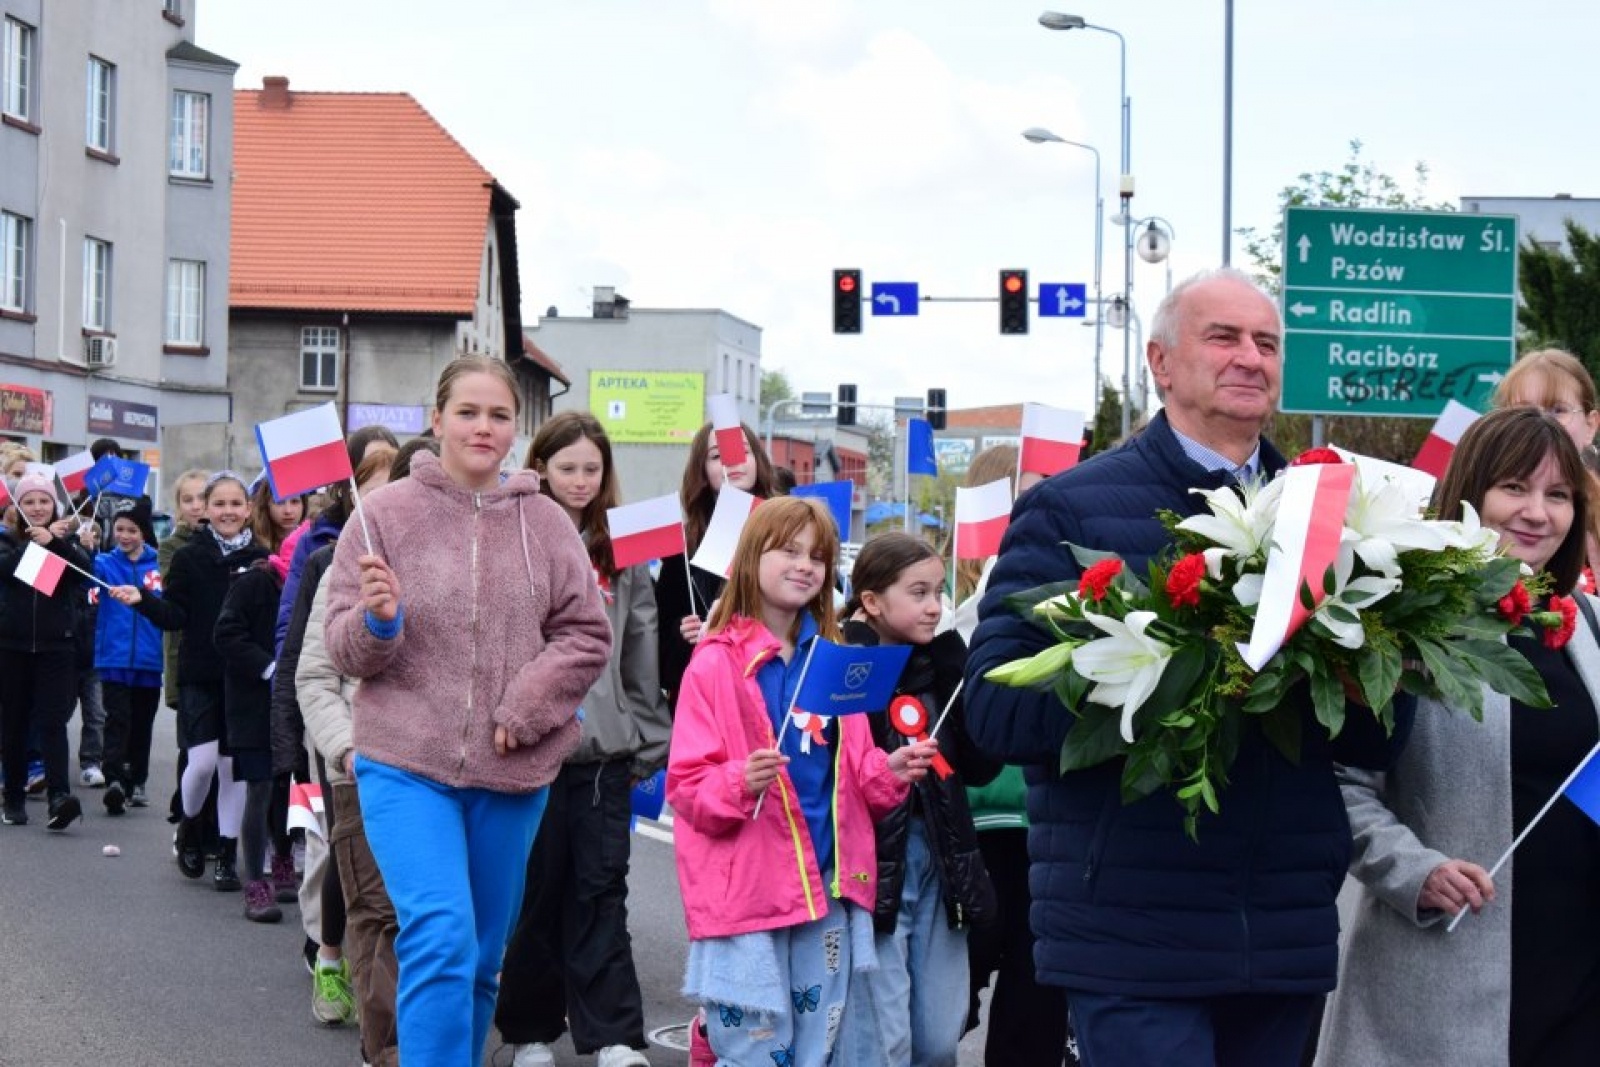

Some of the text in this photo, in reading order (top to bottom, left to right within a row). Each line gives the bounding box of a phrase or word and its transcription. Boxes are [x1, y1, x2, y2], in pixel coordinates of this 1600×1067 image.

[1330, 222, 1511, 253] Wodzisław Śl.
[1330, 257, 1405, 282] Pszów
[1329, 300, 1412, 325] Radlin
[1328, 342, 1438, 368] Racibórz
[598, 377, 648, 389] APTEKA
[355, 405, 416, 422] KWIATY
